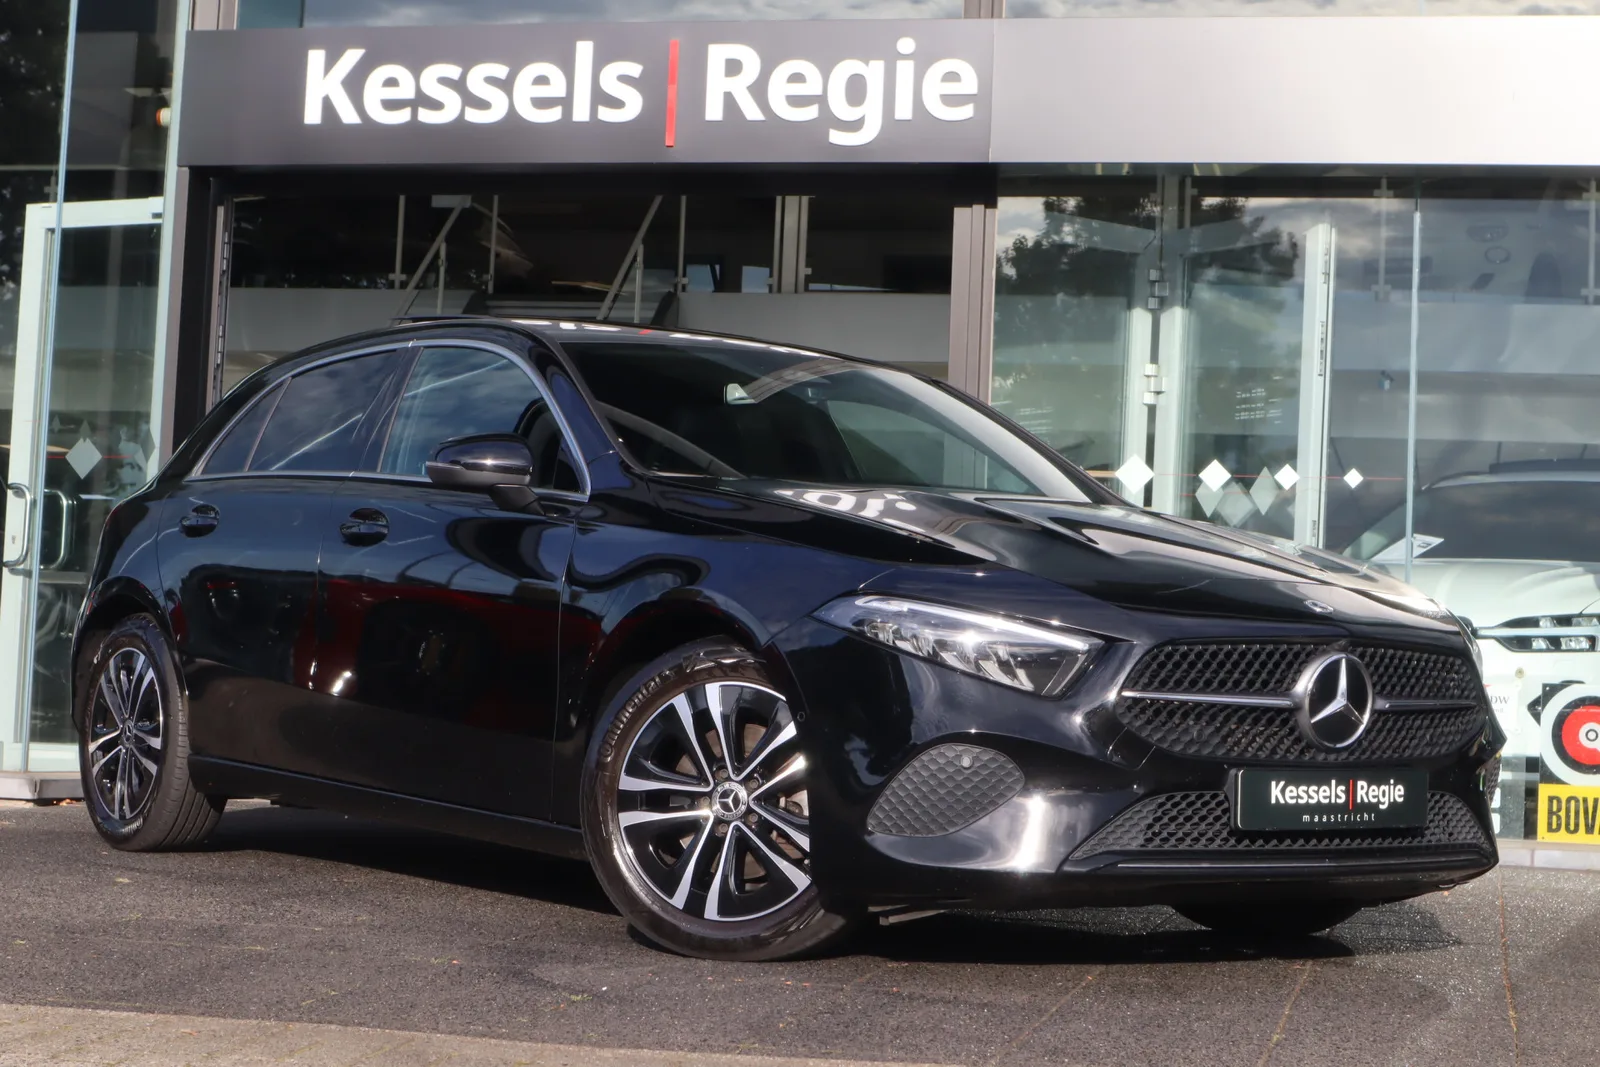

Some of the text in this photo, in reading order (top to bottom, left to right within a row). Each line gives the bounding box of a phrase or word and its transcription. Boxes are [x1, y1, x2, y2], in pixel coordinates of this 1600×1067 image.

[303, 36, 979, 147] Kessels Regie
[1490, 695, 1510, 705] DW
[600, 674, 664, 763] Continental
[1270, 778, 1405, 810] Kessels Regie
[1302, 812, 1376, 823] maastricht
[1547, 795, 1600, 835] BOV
